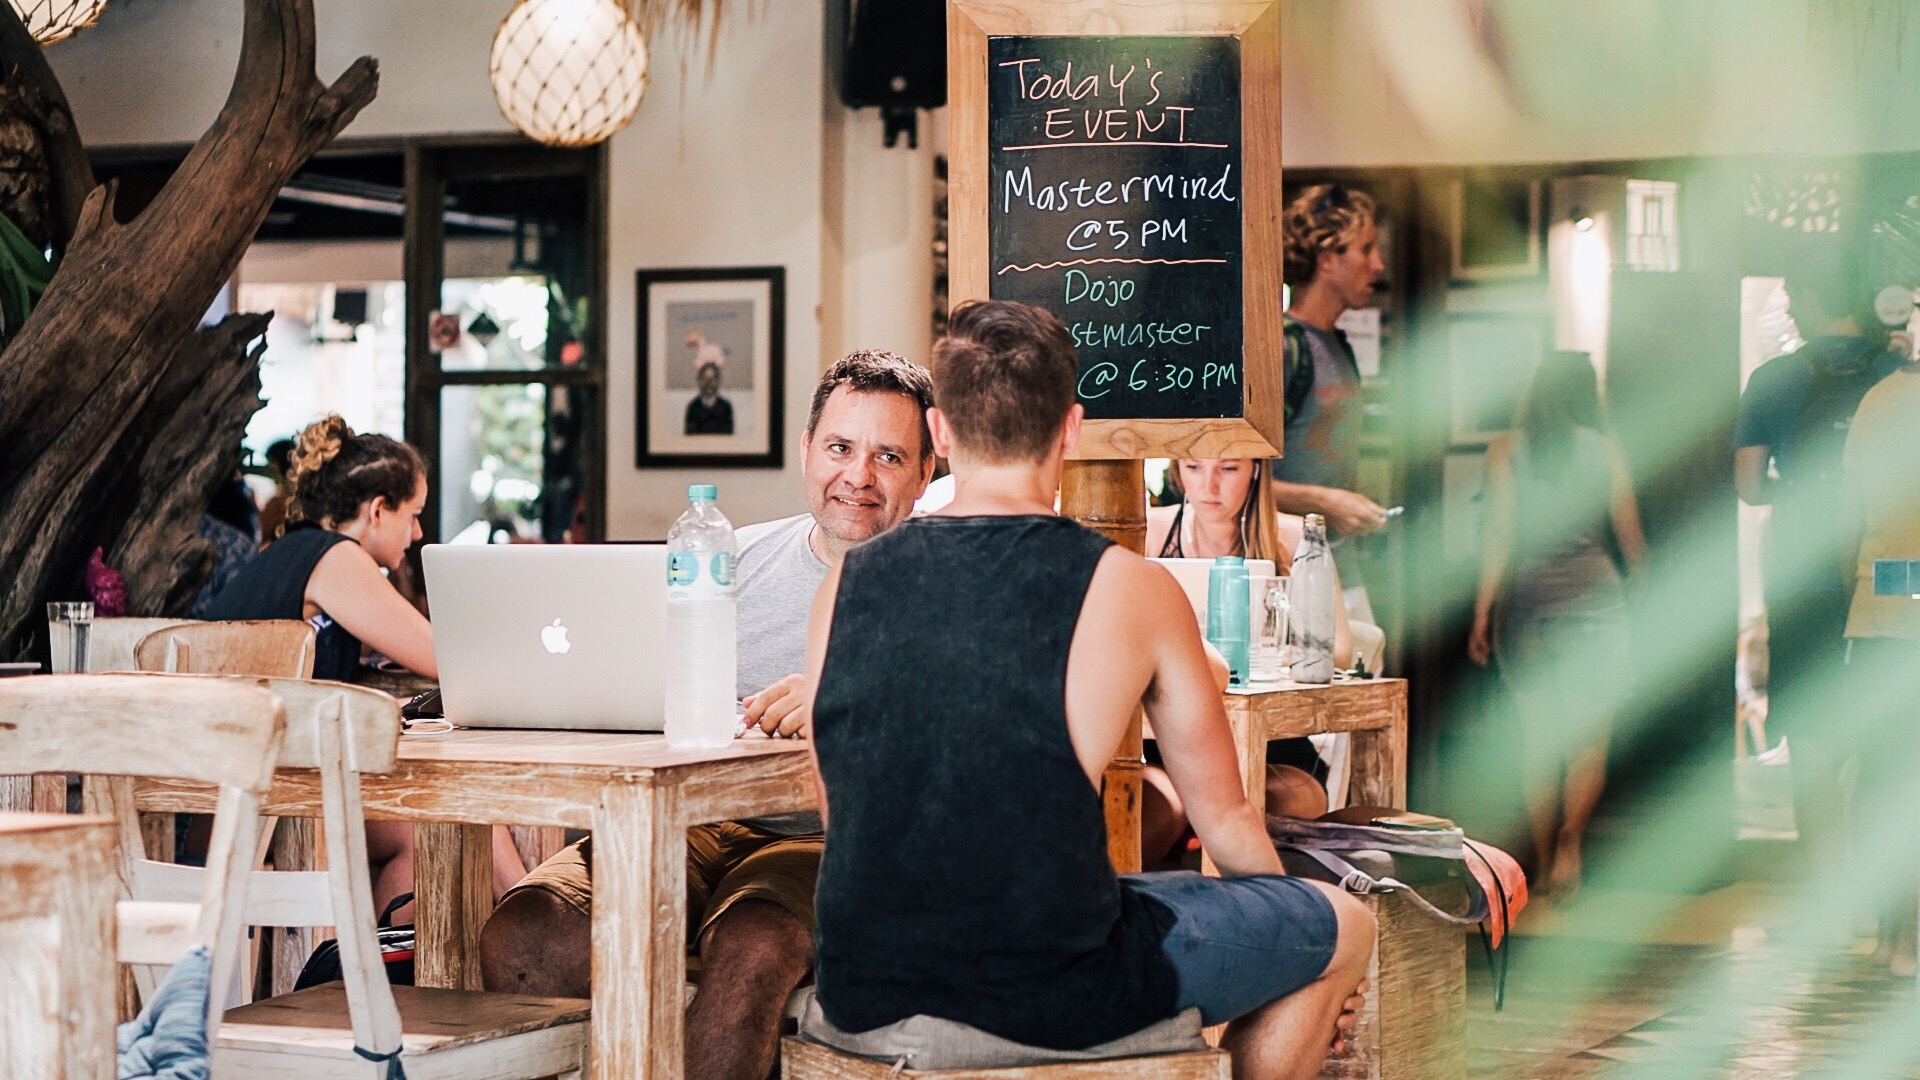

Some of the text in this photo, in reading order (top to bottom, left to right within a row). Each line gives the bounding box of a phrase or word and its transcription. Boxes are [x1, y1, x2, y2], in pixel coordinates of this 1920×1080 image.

[998, 57, 1164, 106] Today's
[1045, 106, 1195, 141] EVENT
[1004, 163, 1236, 213] Mastermind
[1141, 218, 1188, 247] PM
[1065, 269, 1136, 307] Dojo
[1064, 321, 1211, 348] stmaster
[1127, 359, 1194, 392] 6:30
[1202, 362, 1237, 390] PM
